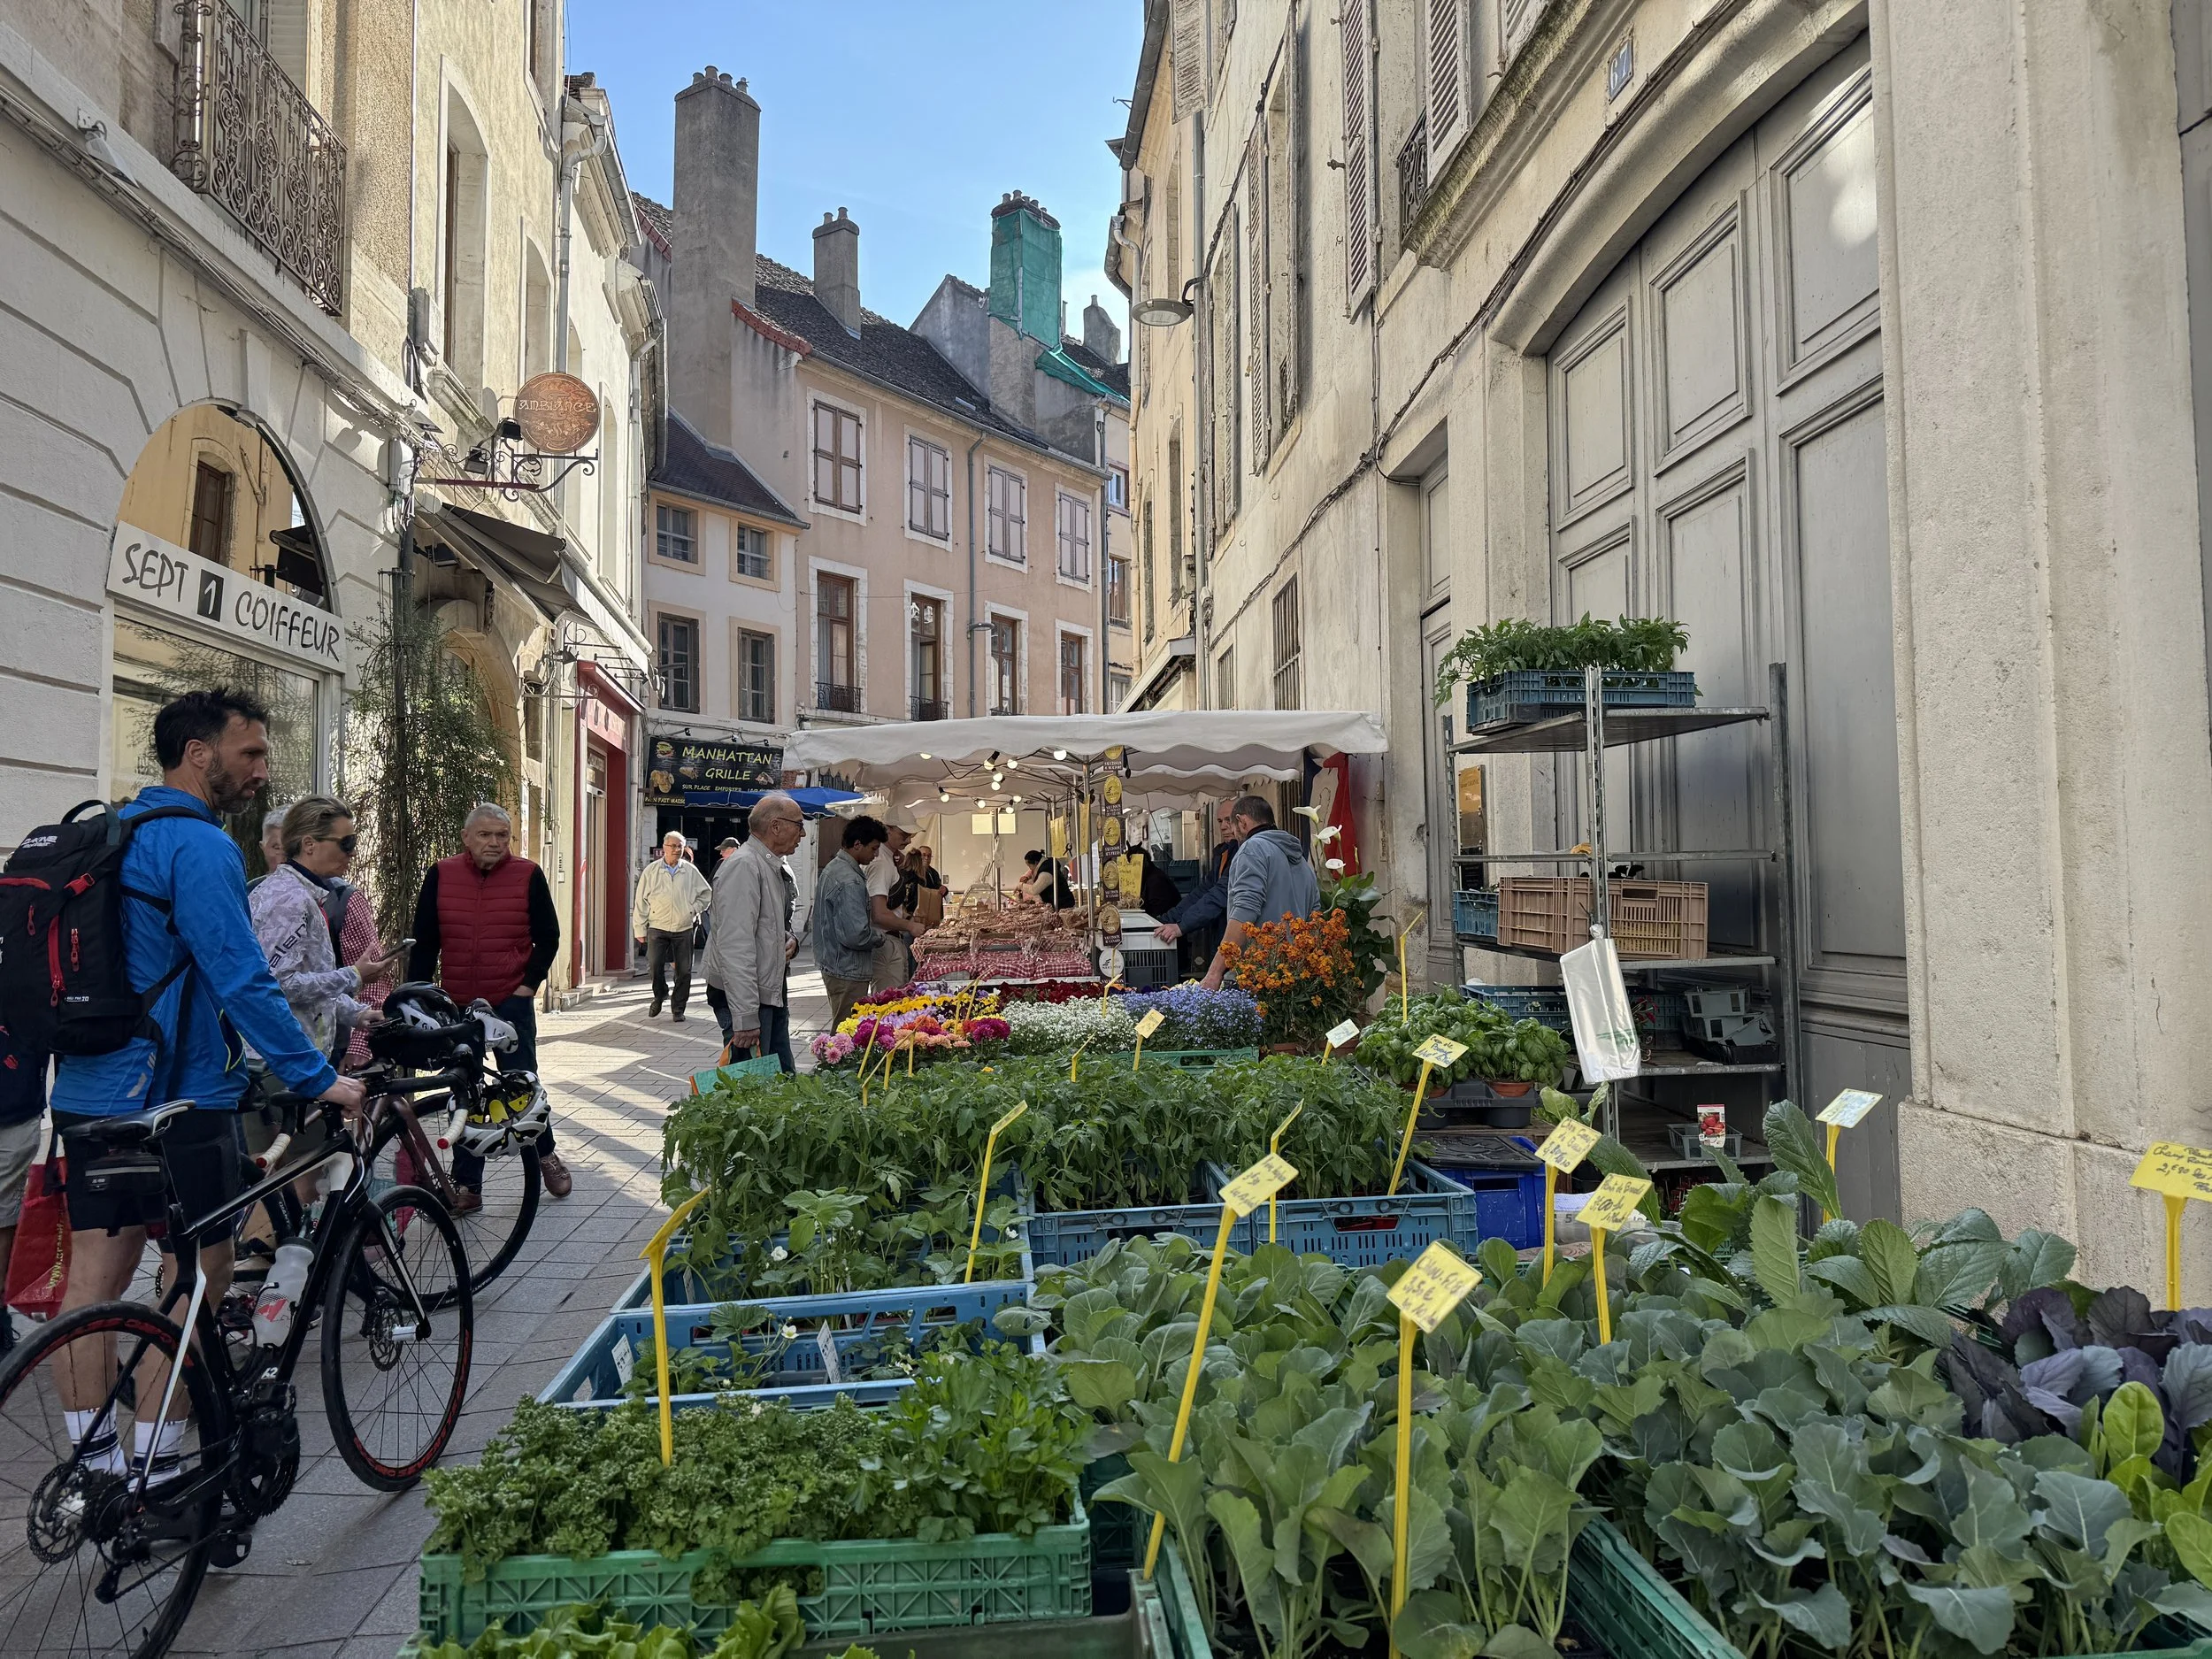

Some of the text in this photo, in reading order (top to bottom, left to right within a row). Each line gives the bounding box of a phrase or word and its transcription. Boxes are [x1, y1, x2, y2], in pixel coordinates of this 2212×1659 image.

[518, 400, 597, 413] AMBIANCE
[122, 542, 188, 603] SEPT
[235, 591, 340, 663] COIFFEUR
[682, 747, 772, 764] MANHATTAN
[705, 768, 751, 780] GRILLE
